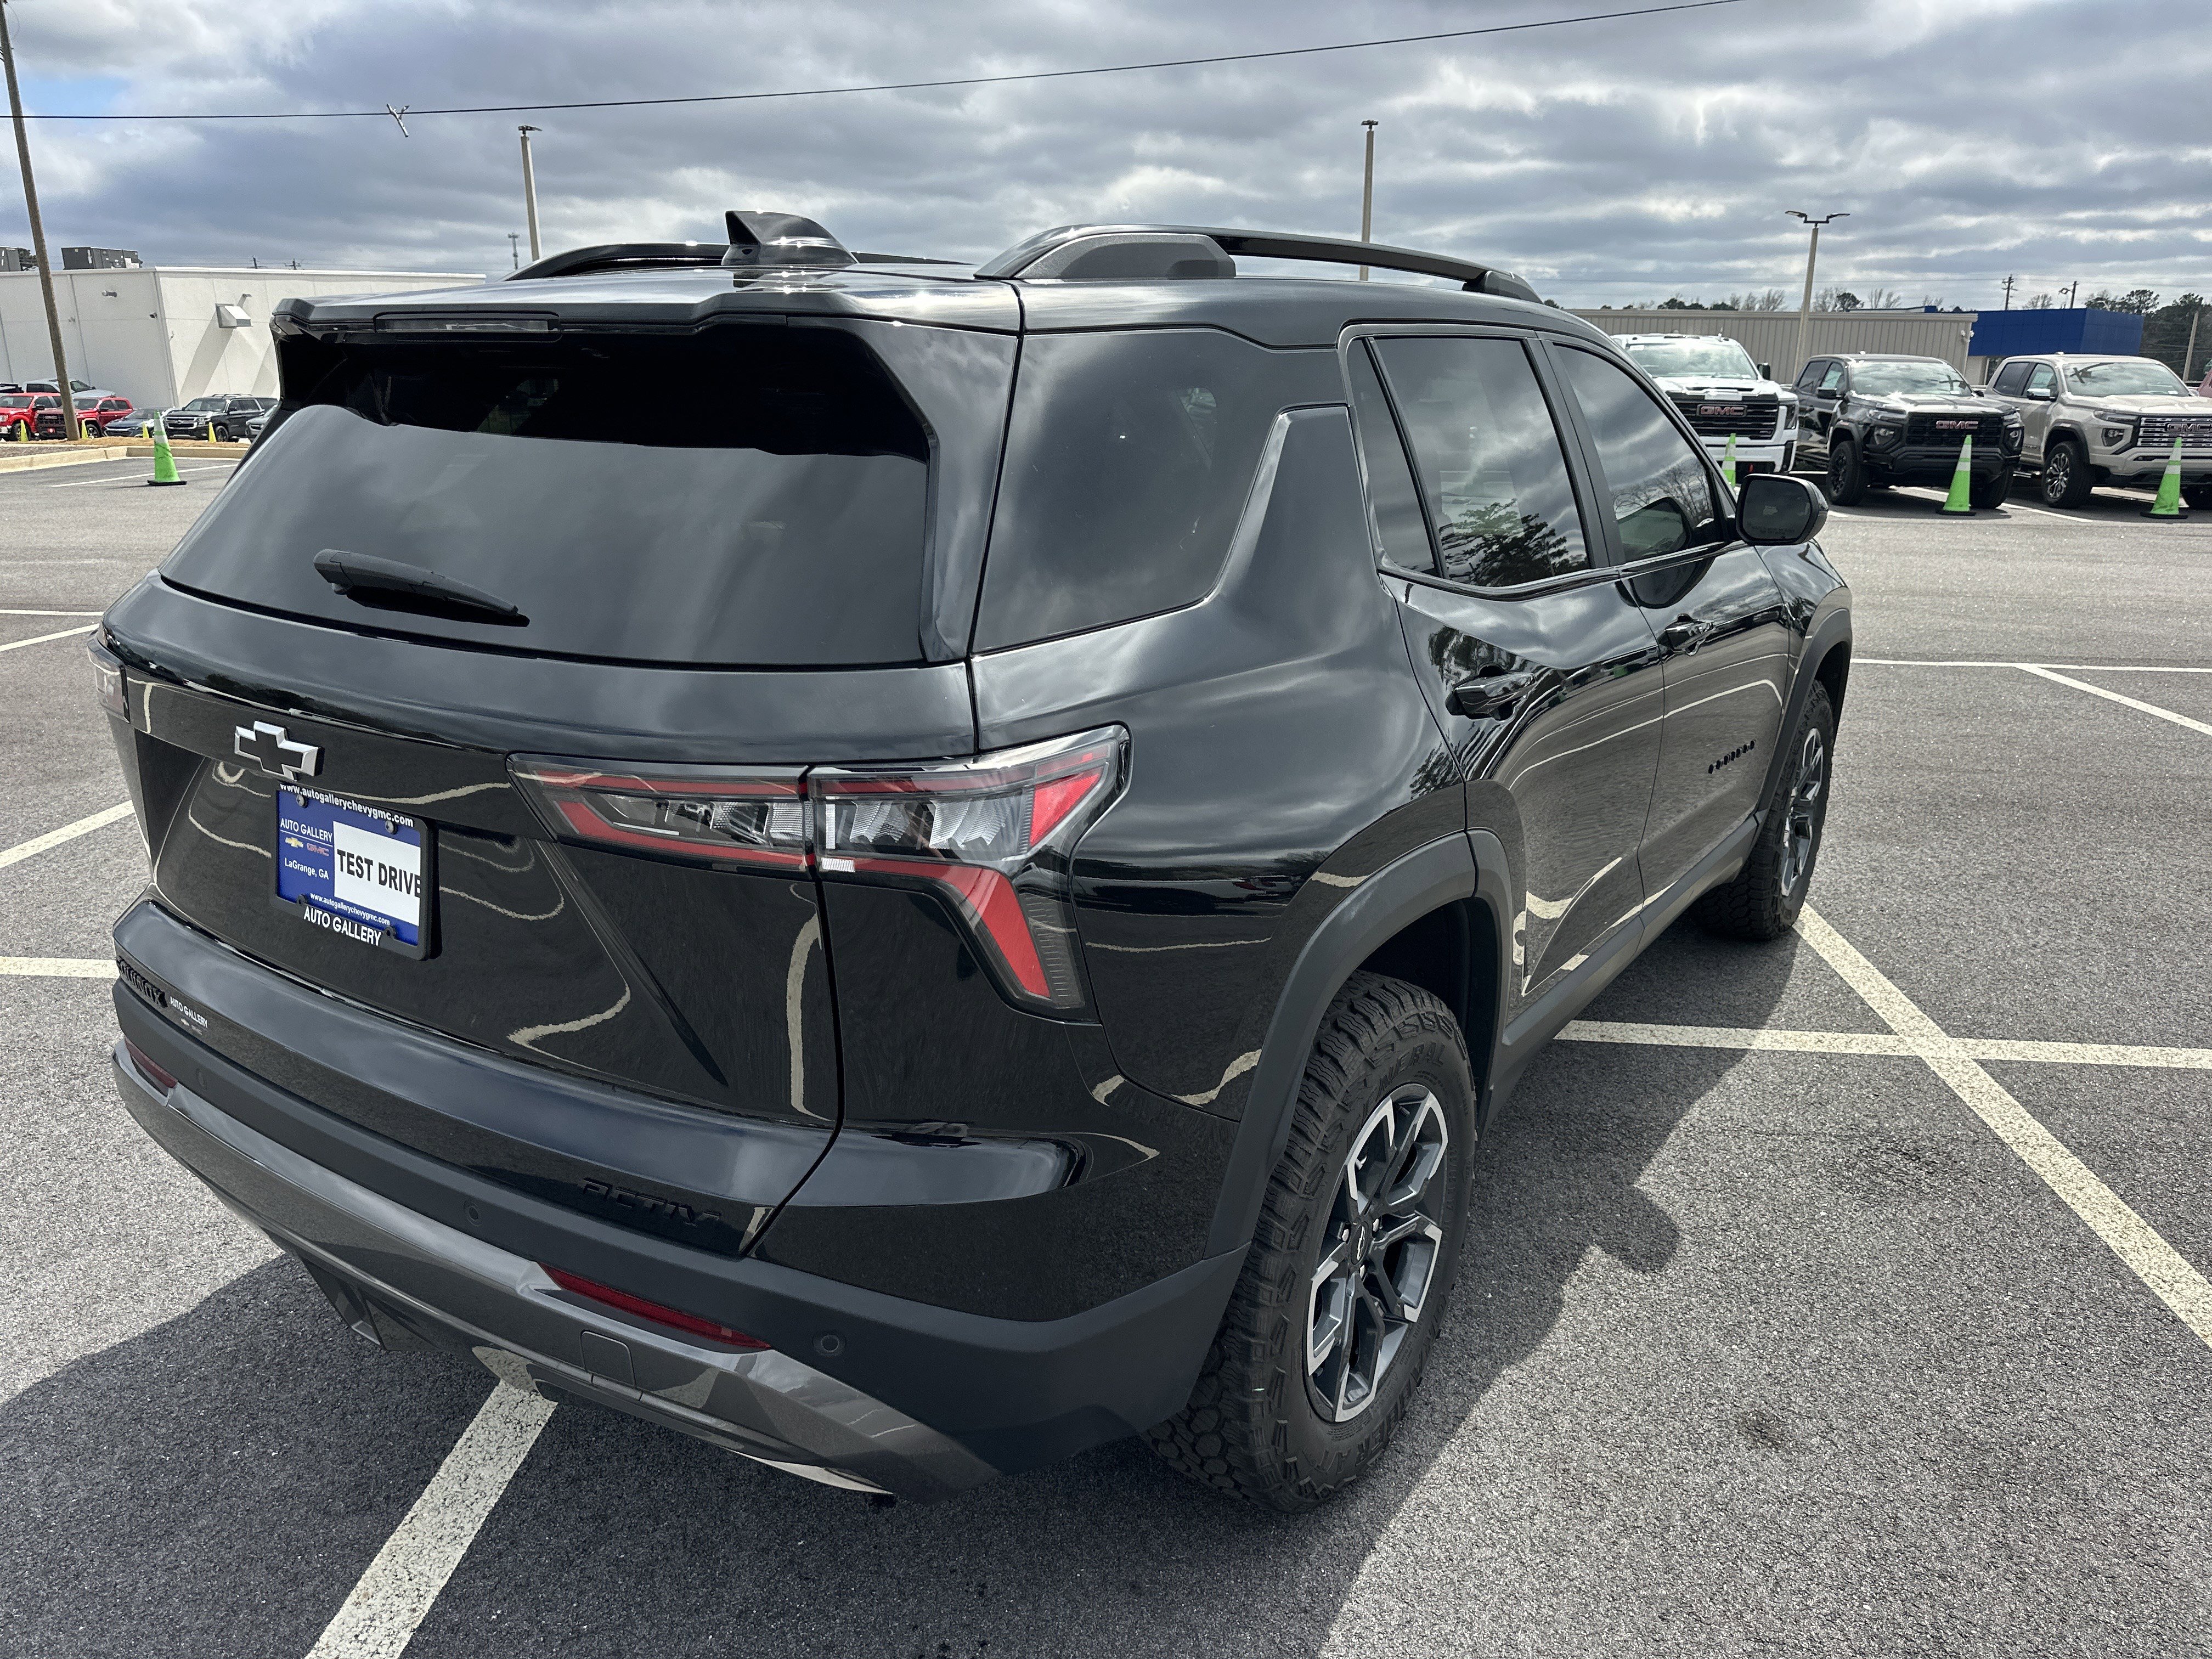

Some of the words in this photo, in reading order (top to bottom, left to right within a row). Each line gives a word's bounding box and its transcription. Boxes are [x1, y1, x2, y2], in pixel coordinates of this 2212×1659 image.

[1701, 406, 1745, 415] GMC
[1936, 420, 1978, 429] GMC
[2167, 424, 2211, 432] GMC
[280, 783, 414, 827] www.autogallerychevygmc.com
[280, 818, 299, 832] AUTO
[301, 824, 332, 843] GALLERY
[307, 843, 329, 856] GMC
[285, 857, 317, 877] LaGrange,
[319, 868, 329, 880] GA
[337, 849, 374, 882] TEST
[378, 862, 421, 898] DRIVE
[310, 893, 390, 926] www.autogallerychevygmc.com
[303, 906, 330, 928] AUTO
[332, 917, 381, 946] GALLERY
[170, 996, 183, 1012] AUTO
[184, 1006, 208, 1028] GALLERY
